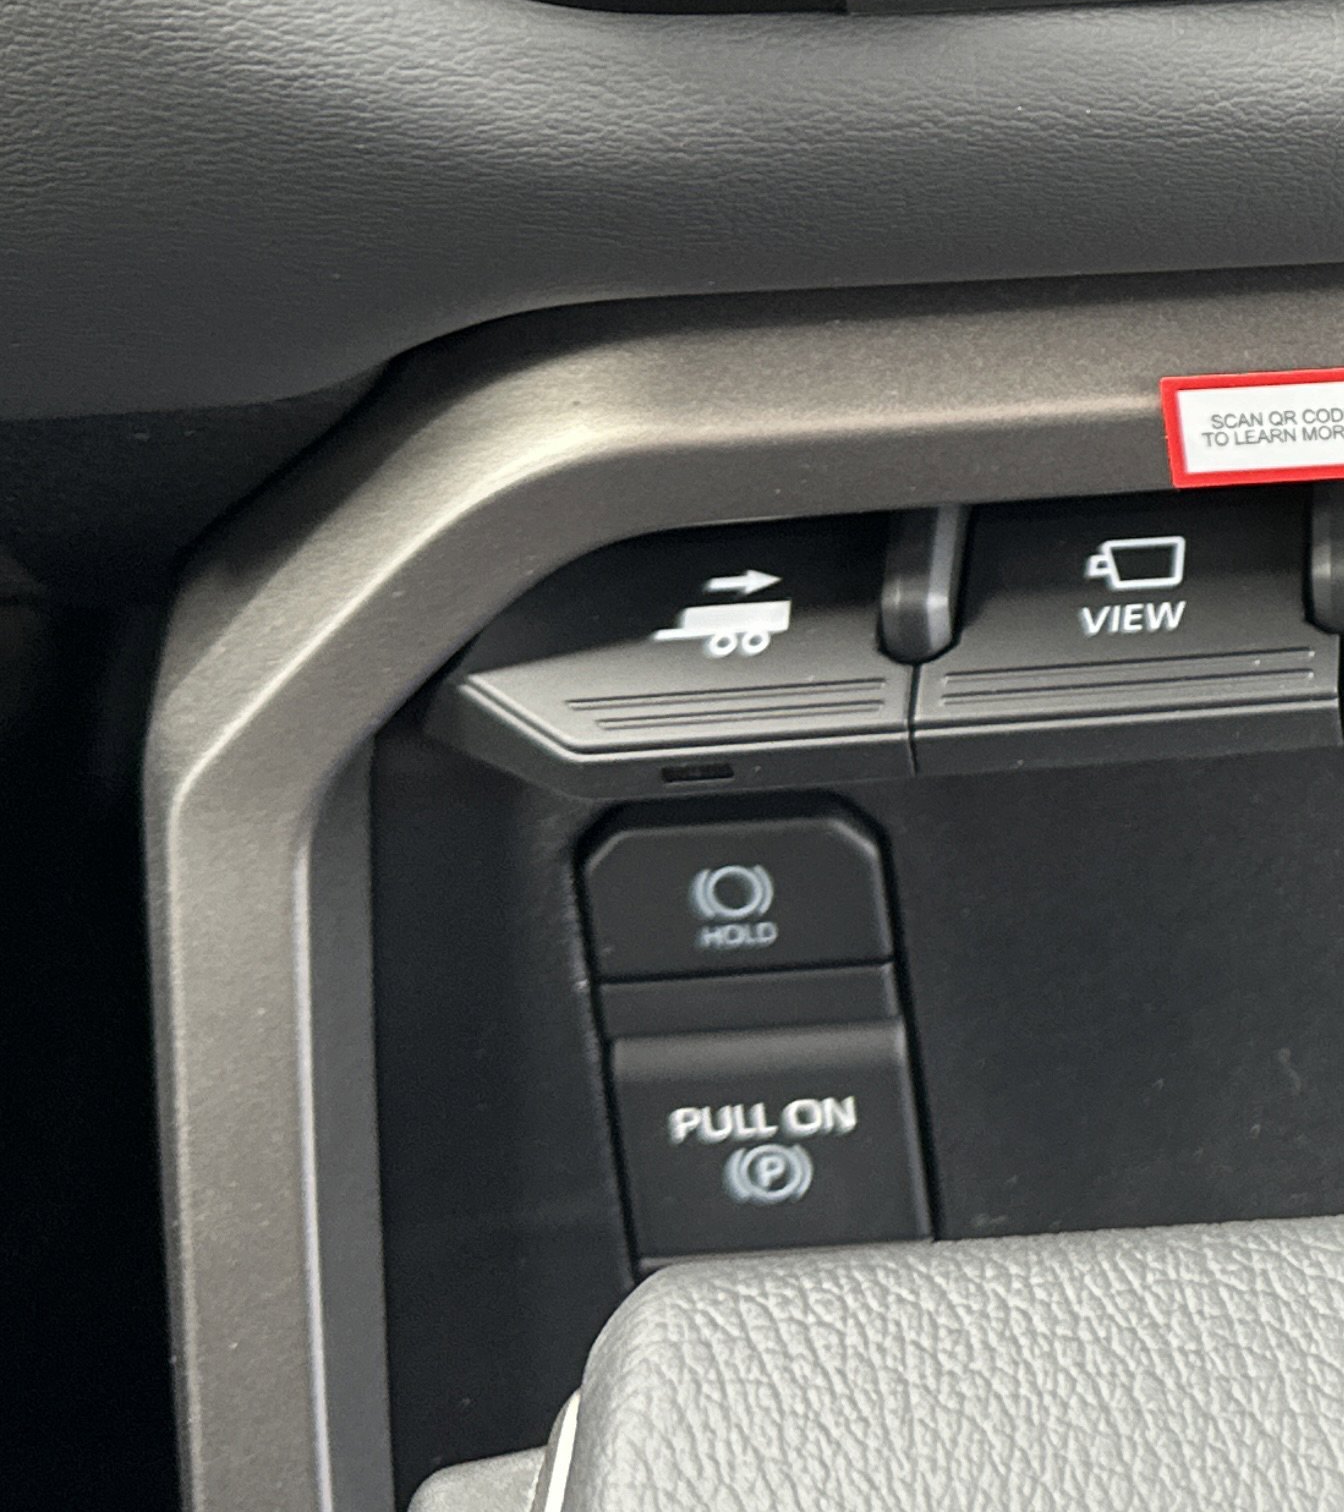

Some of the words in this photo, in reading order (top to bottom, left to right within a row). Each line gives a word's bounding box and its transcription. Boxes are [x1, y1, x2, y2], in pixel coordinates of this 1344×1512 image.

[1210, 412, 1264, 430] SCAN
[1268, 410, 1298, 428] QR
[1200, 431, 1230, 448] TO
[1234, 428, 1298, 446] LEARN
[1079, 599, 1188, 637] VIEW
[697, 920, 779, 949] HOLD
[667, 1101, 779, 1145] PULL
[781, 1094, 858, 1139] ON
